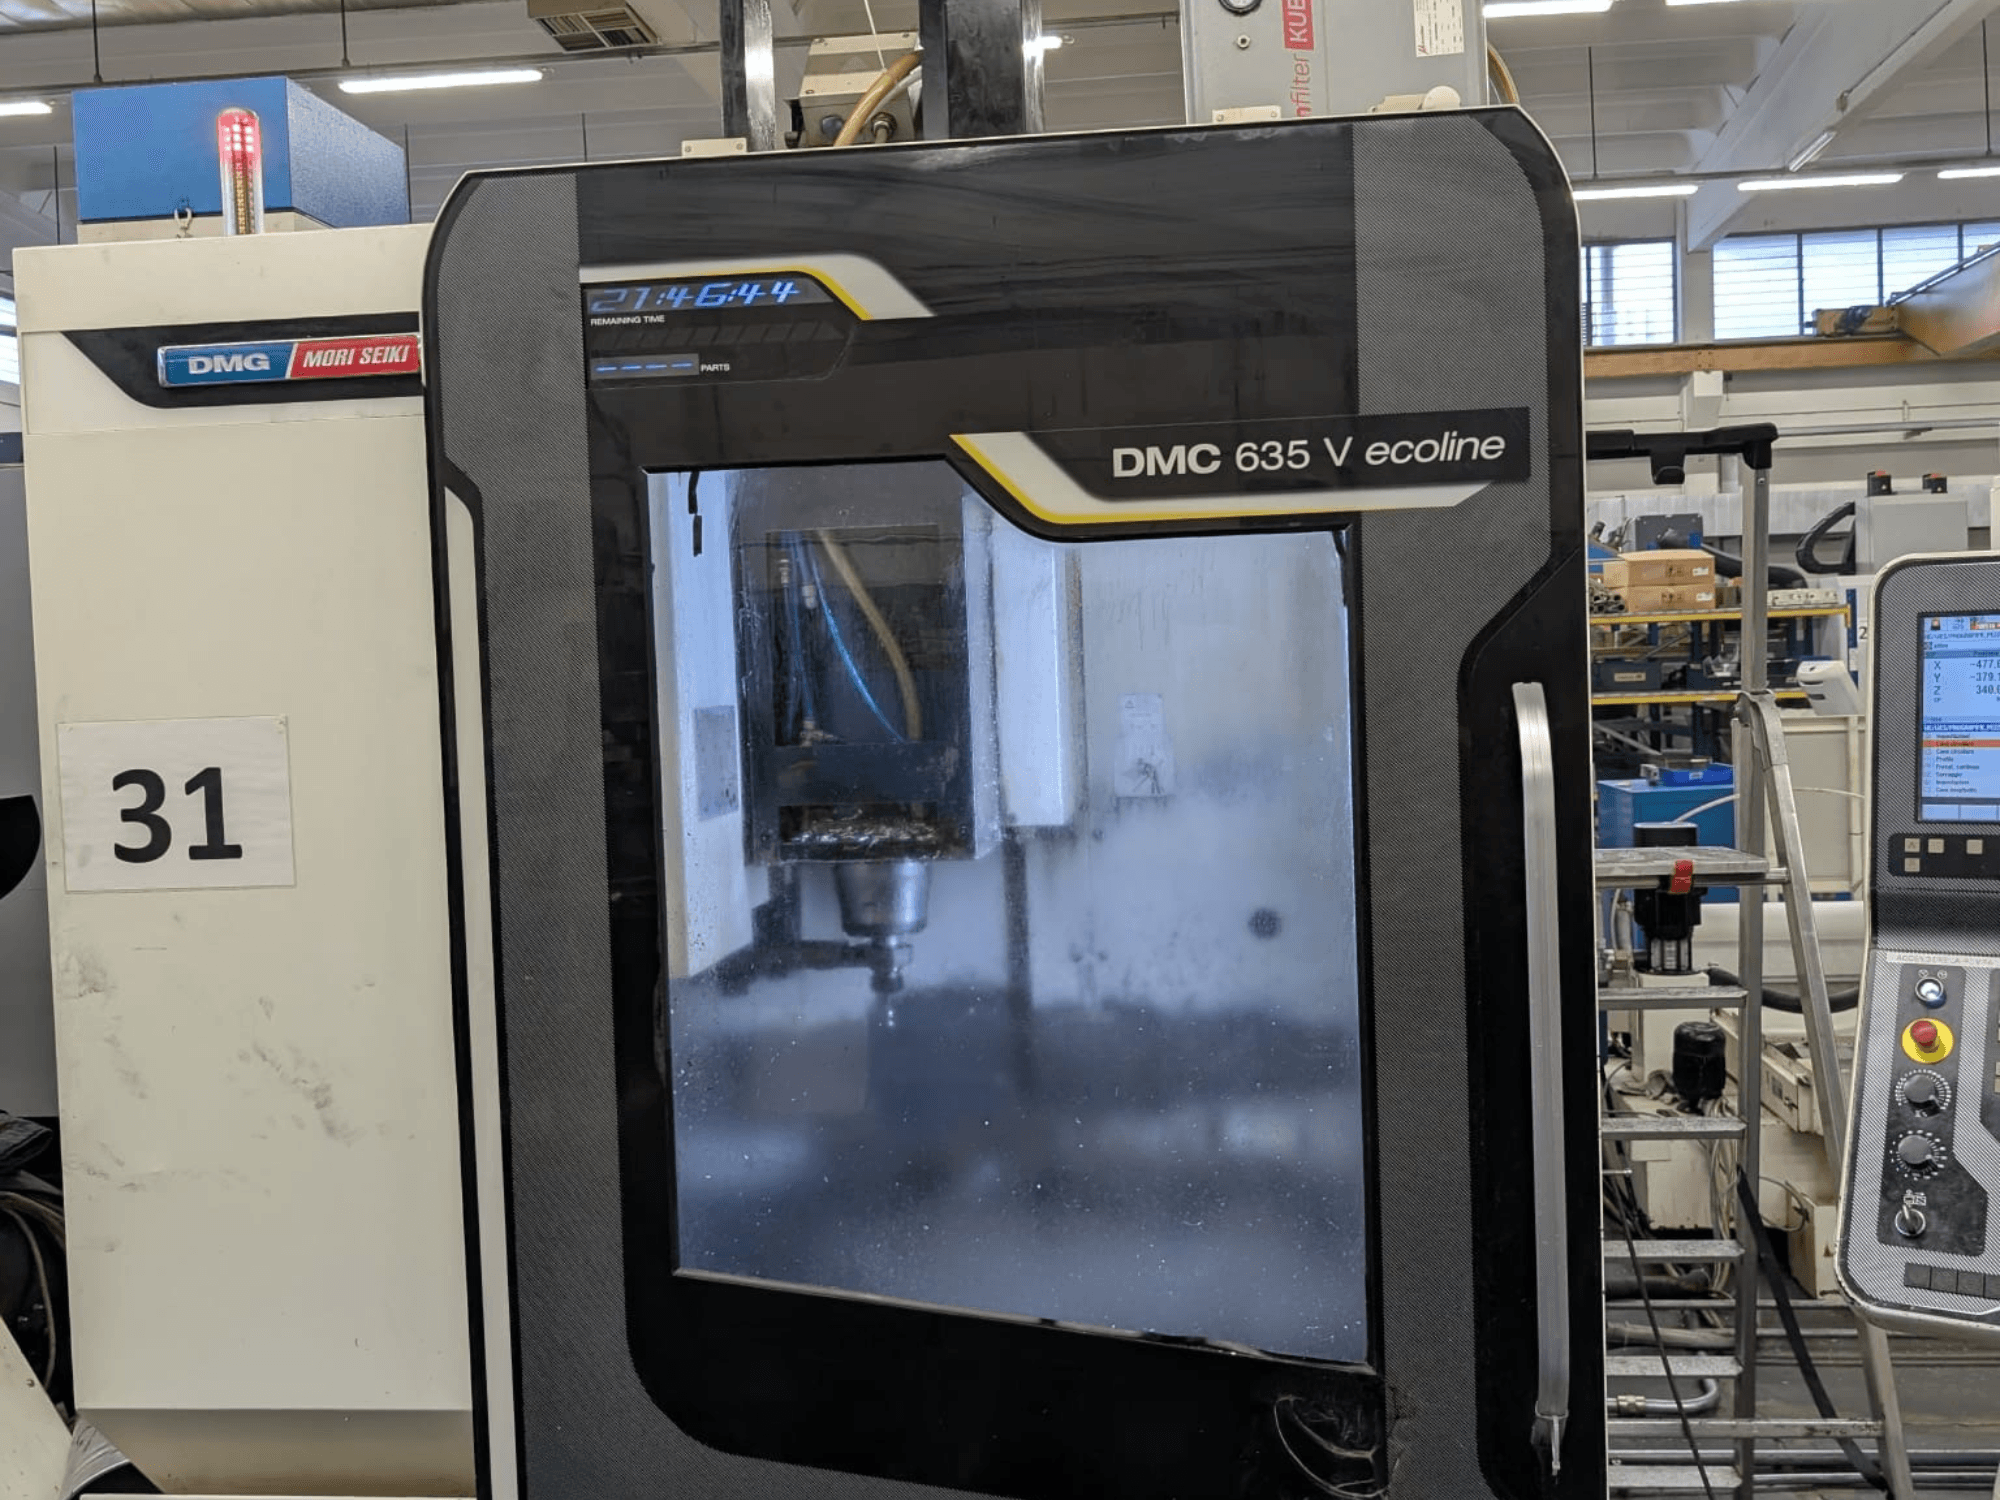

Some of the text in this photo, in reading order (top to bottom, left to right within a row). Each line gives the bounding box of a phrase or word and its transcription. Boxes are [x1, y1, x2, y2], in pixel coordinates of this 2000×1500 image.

[590, 315, 665, 326] REMAINING TIME
[189, 345, 410, 374] DMG MORI SEIKI
[701, 363, 730, 371] PARTS
[1113, 431, 1505, 478] DMC 635 V ecoline
[113, 767, 242, 863] 31
